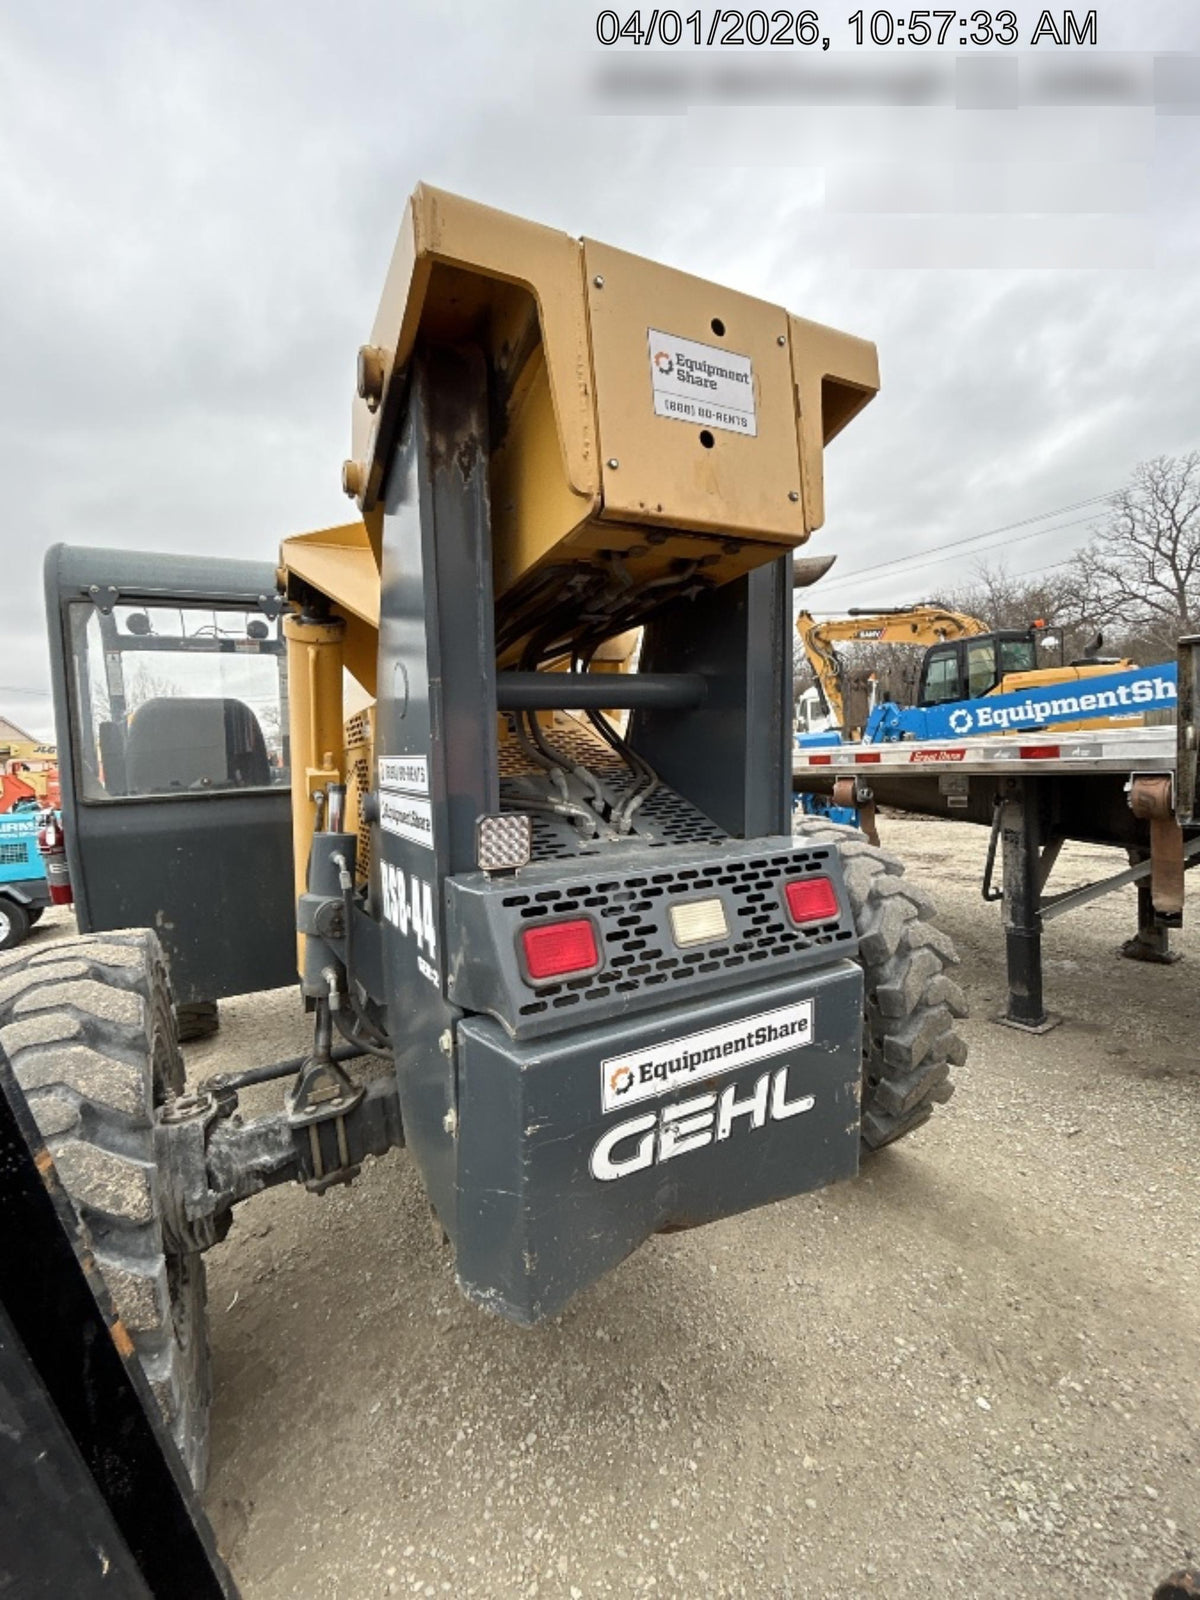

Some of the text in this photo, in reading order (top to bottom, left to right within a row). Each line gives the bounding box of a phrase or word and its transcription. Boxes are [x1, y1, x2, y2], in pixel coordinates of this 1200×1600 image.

[675, 353, 750, 385] Equipment
[676, 368, 718, 390] Share
[976, 677, 1178, 728] EquipmentSh
[33, 745, 57, 755] JLG
[638, 1017, 809, 1084] EquipmentShare
[588, 1065, 816, 1181] GEHL
